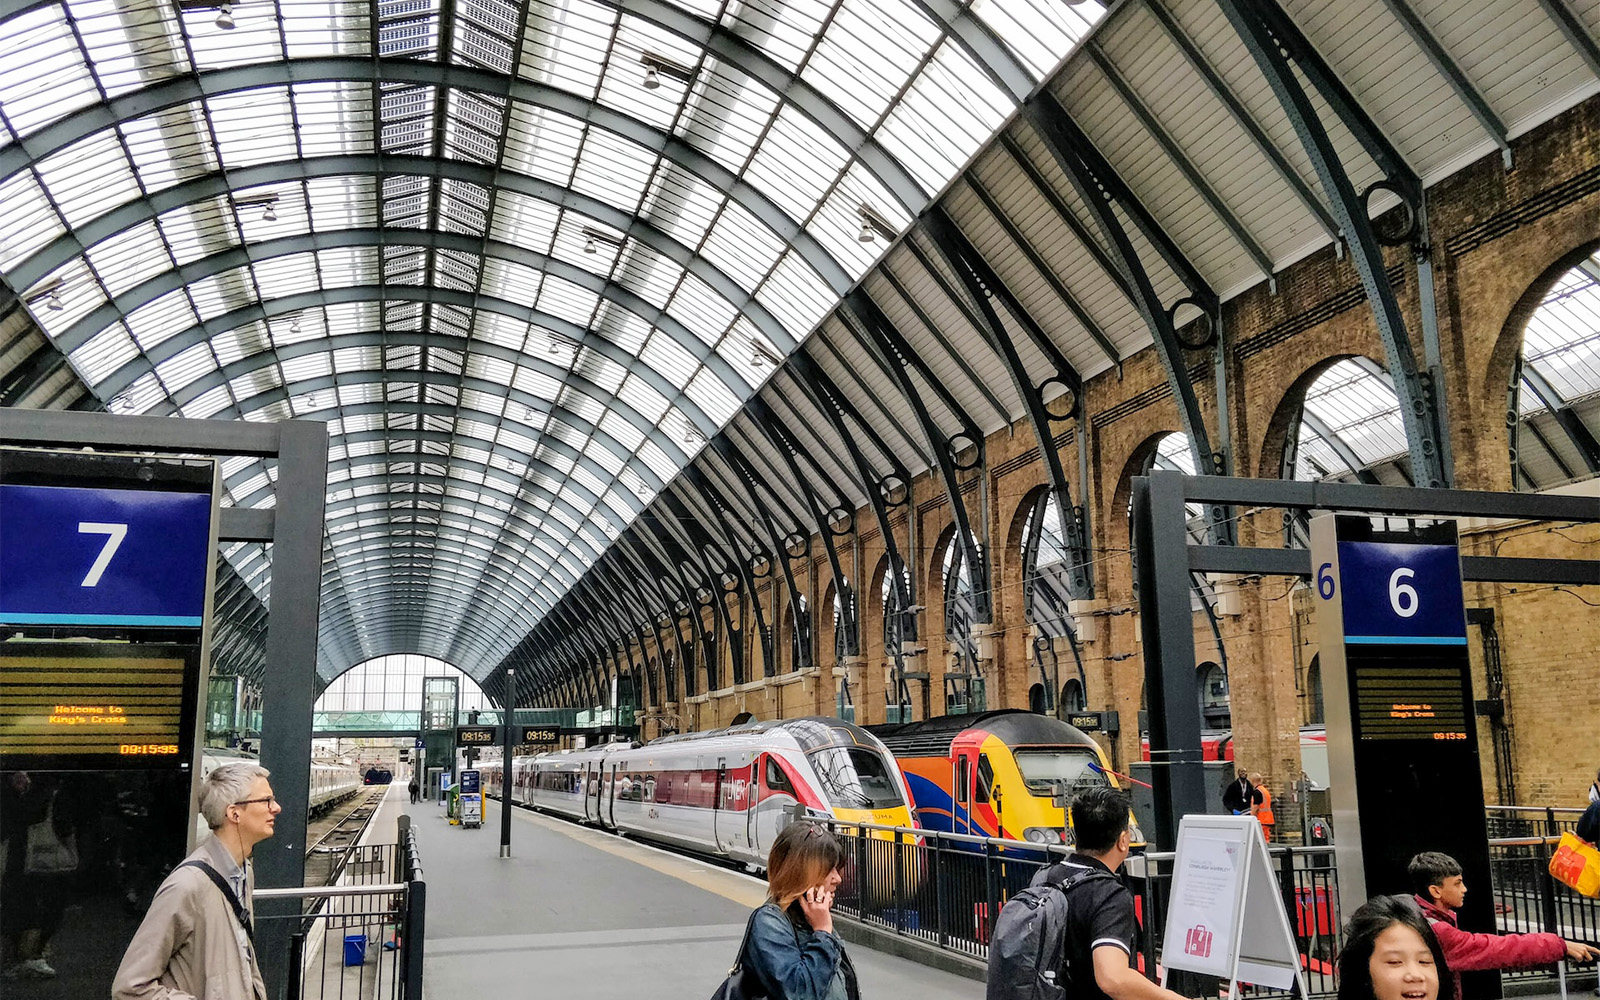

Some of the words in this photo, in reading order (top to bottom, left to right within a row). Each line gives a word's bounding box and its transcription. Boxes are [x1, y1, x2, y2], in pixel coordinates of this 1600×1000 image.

[78, 522, 128, 587] 7
[1318, 563, 1335, 600] 6
[1389, 567, 1419, 618] 6
[49, 716, 86, 725] King's
[55, 706, 103, 714] Welcome
[109, 706, 122, 714] to
[120, 745, 178, 754] 09:15:35
[728, 776, 746, 802] LNER
